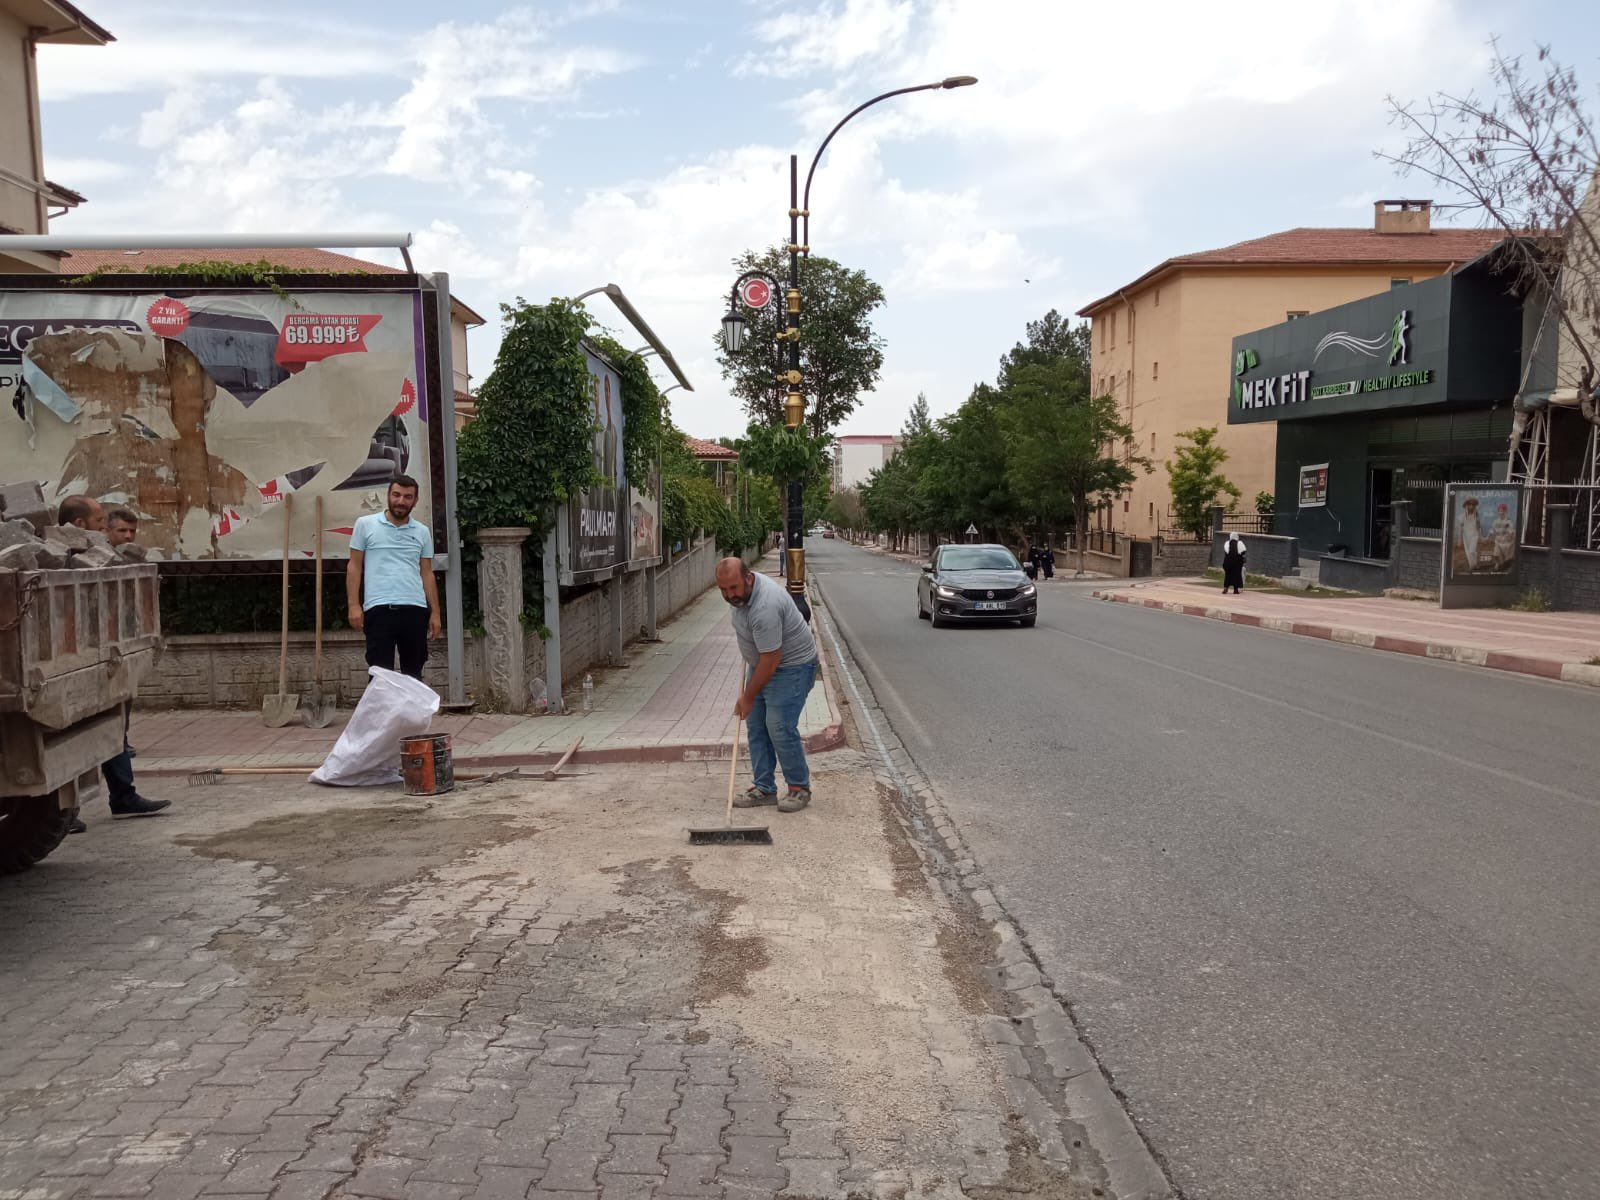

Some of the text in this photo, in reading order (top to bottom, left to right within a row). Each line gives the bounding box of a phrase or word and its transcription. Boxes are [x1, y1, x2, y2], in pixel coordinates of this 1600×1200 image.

[158, 306, 164, 314] 2
[321, 317, 339, 325] YATAK
[1363, 376, 1393, 392] HEALTHY
[1393, 370, 1429, 388] LIFESTYLE
[1242, 377, 1277, 409] MEK
[580, 508, 617, 537] PAULMARK
